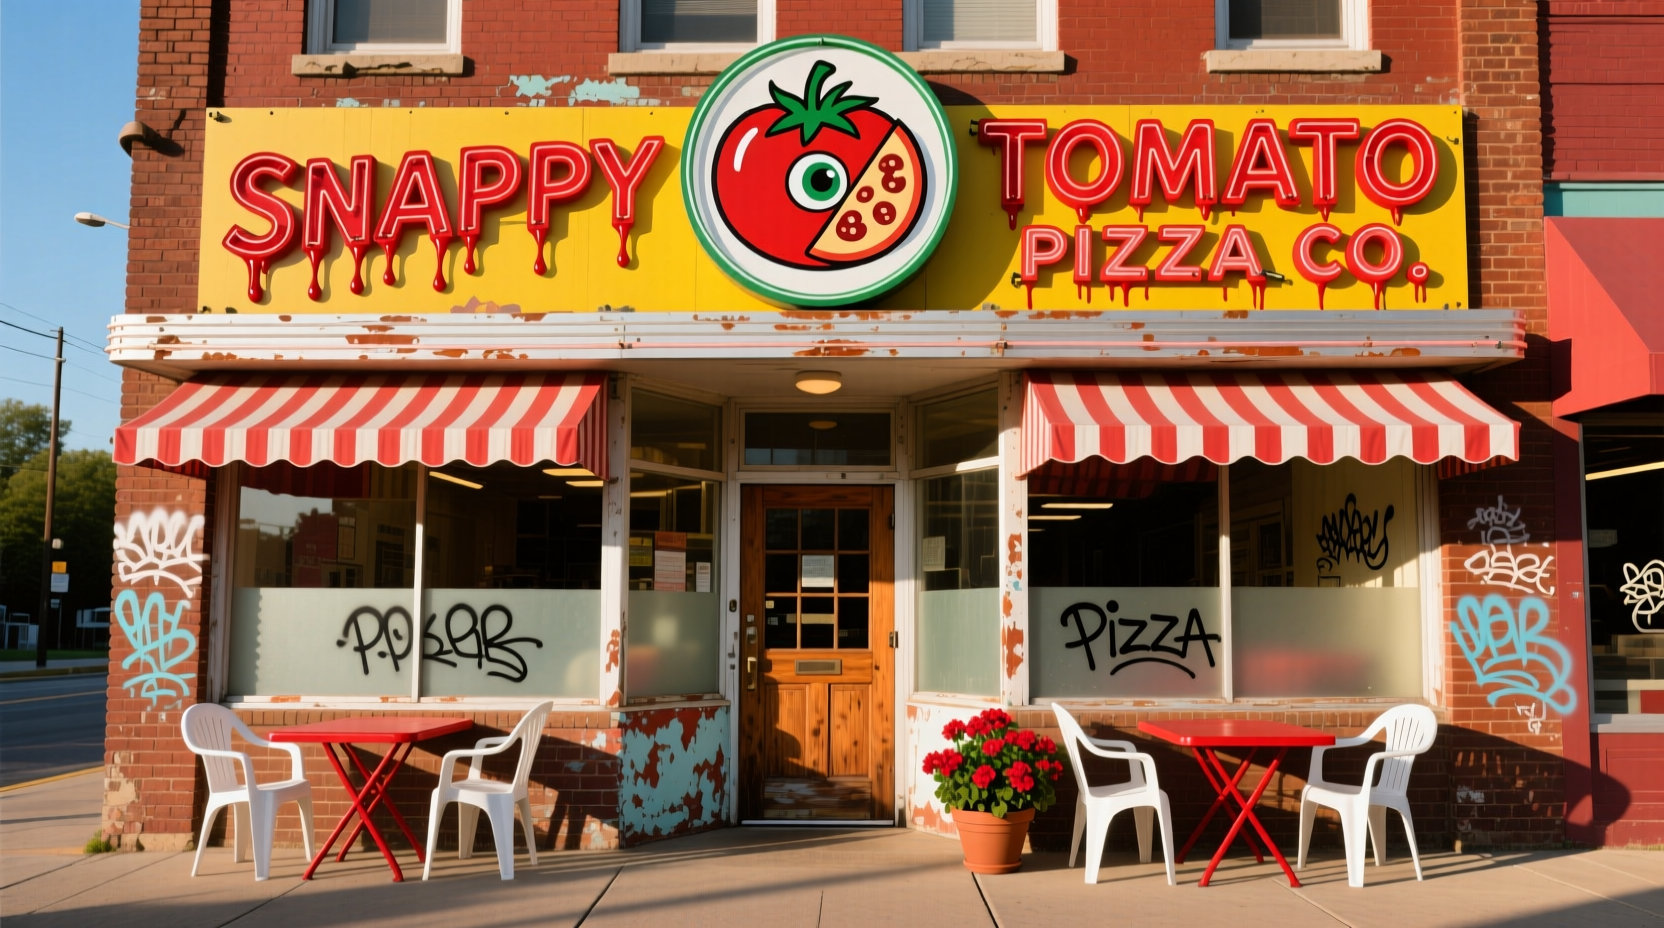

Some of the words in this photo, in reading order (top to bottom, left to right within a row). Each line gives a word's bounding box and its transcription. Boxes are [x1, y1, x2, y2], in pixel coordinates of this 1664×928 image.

[222, 135, 665, 262] SNAPPY
[978, 117, 1440, 212] TOMATO
[1020, 224, 1267, 286] PIZZA
[1292, 223, 1430, 286] CO.
